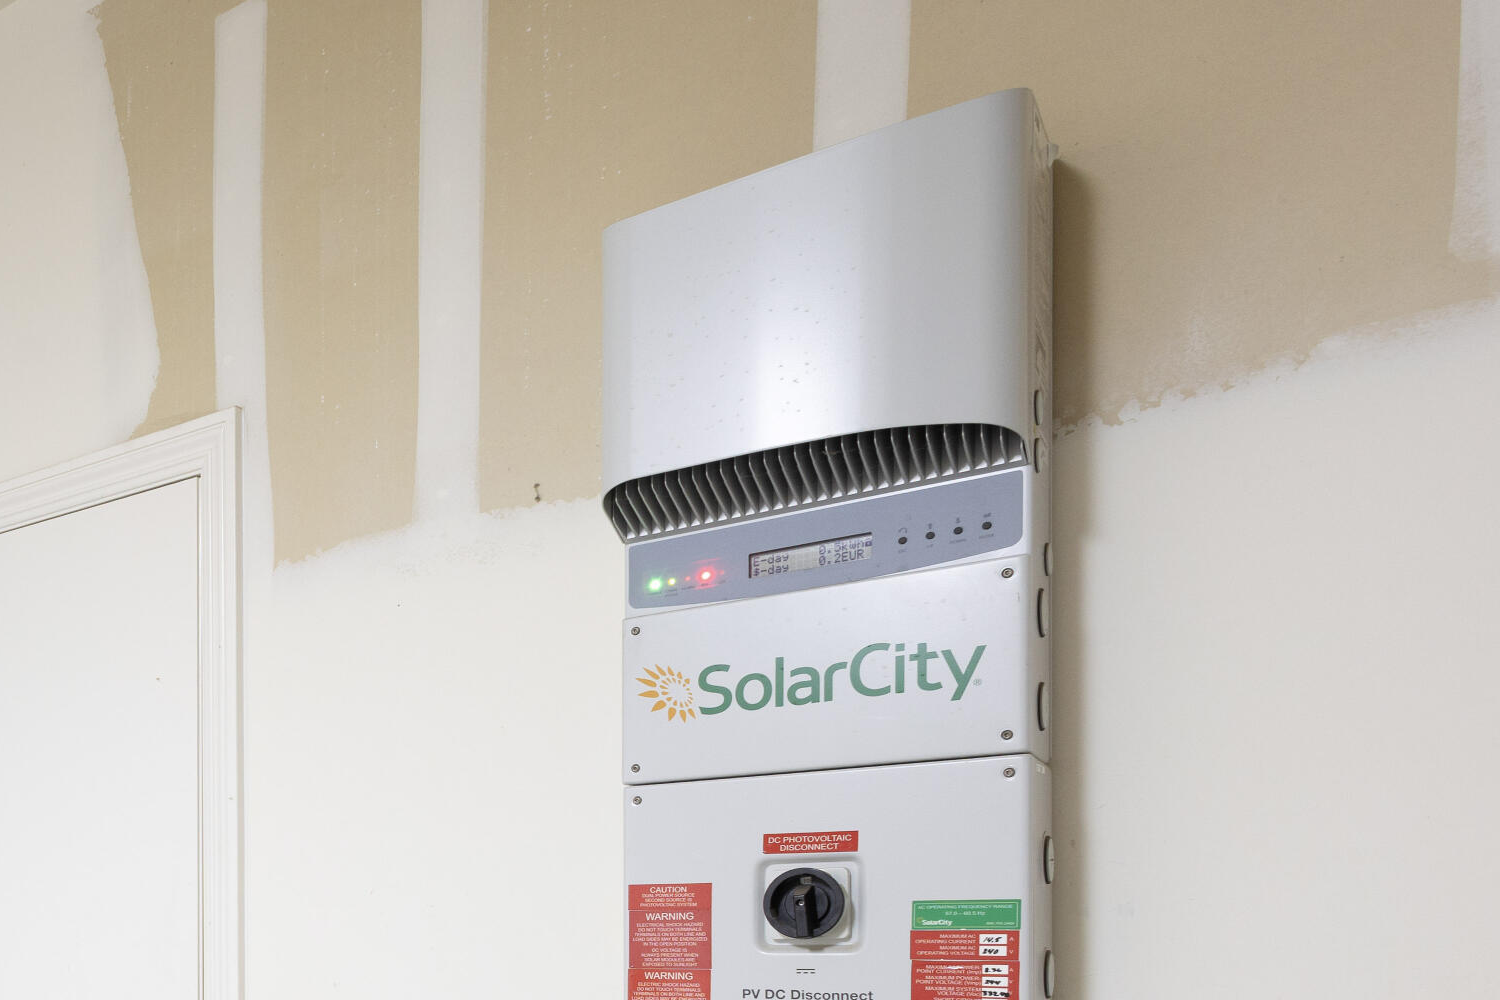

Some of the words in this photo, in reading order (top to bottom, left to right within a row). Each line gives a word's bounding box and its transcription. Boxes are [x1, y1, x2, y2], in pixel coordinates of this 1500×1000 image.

[819, 550, 864, 566] 0.2EUR
[698, 642, 987, 715] SolarCity
[768, 836, 781, 844] DC
[783, 834, 853, 844] PHOTOVOLTAIC
[780, 843, 840, 852] DISCONNECT
[650, 886, 687, 894] CAUTION
[646, 912, 694, 921] WARNING
[922, 919, 953, 927] SolarCity
[644, 972, 694, 980] WARNING
[742, 989, 760, 999] PV
[765, 989, 786, 1000] DC
[791, 989, 874, 1000] Disconnect
